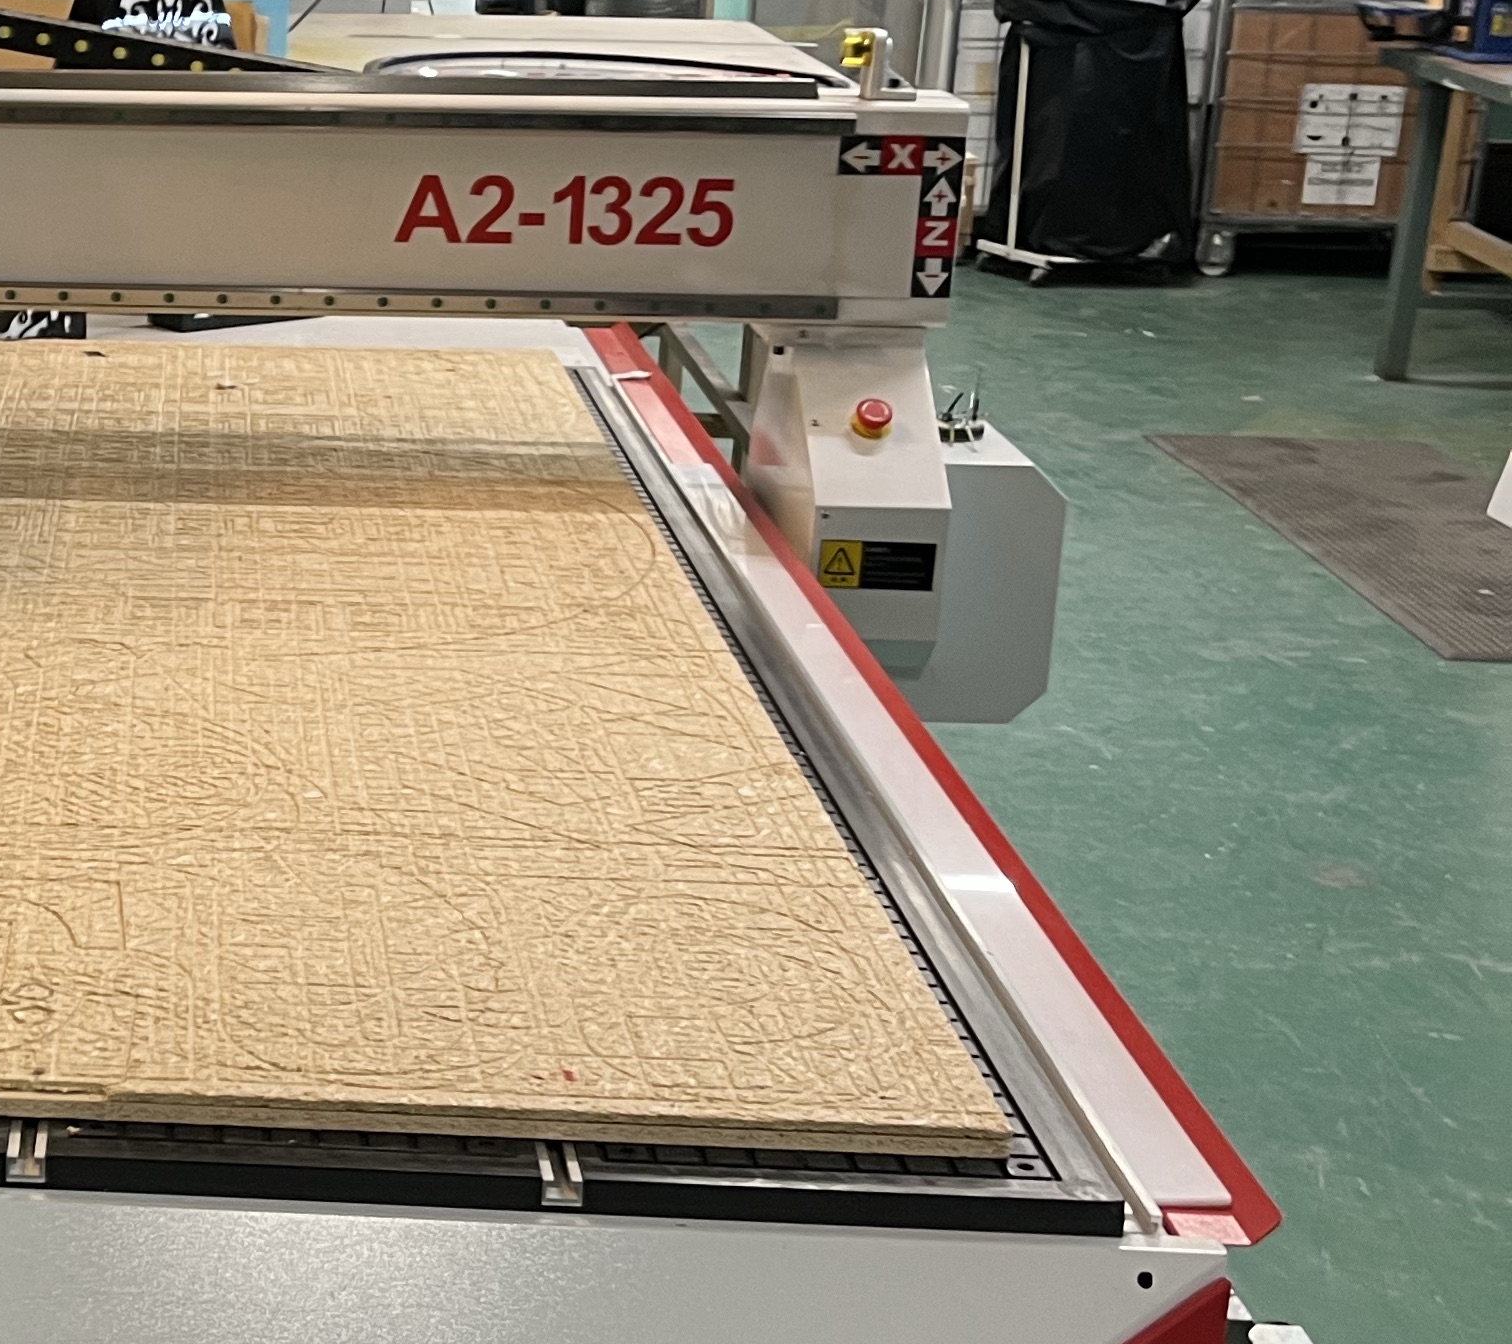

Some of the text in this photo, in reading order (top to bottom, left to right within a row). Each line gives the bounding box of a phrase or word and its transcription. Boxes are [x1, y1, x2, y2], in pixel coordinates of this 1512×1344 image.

[887, 143, 918, 169] X
[393, 174, 735, 247] A2-1325
[921, 220, 951, 247] Z
